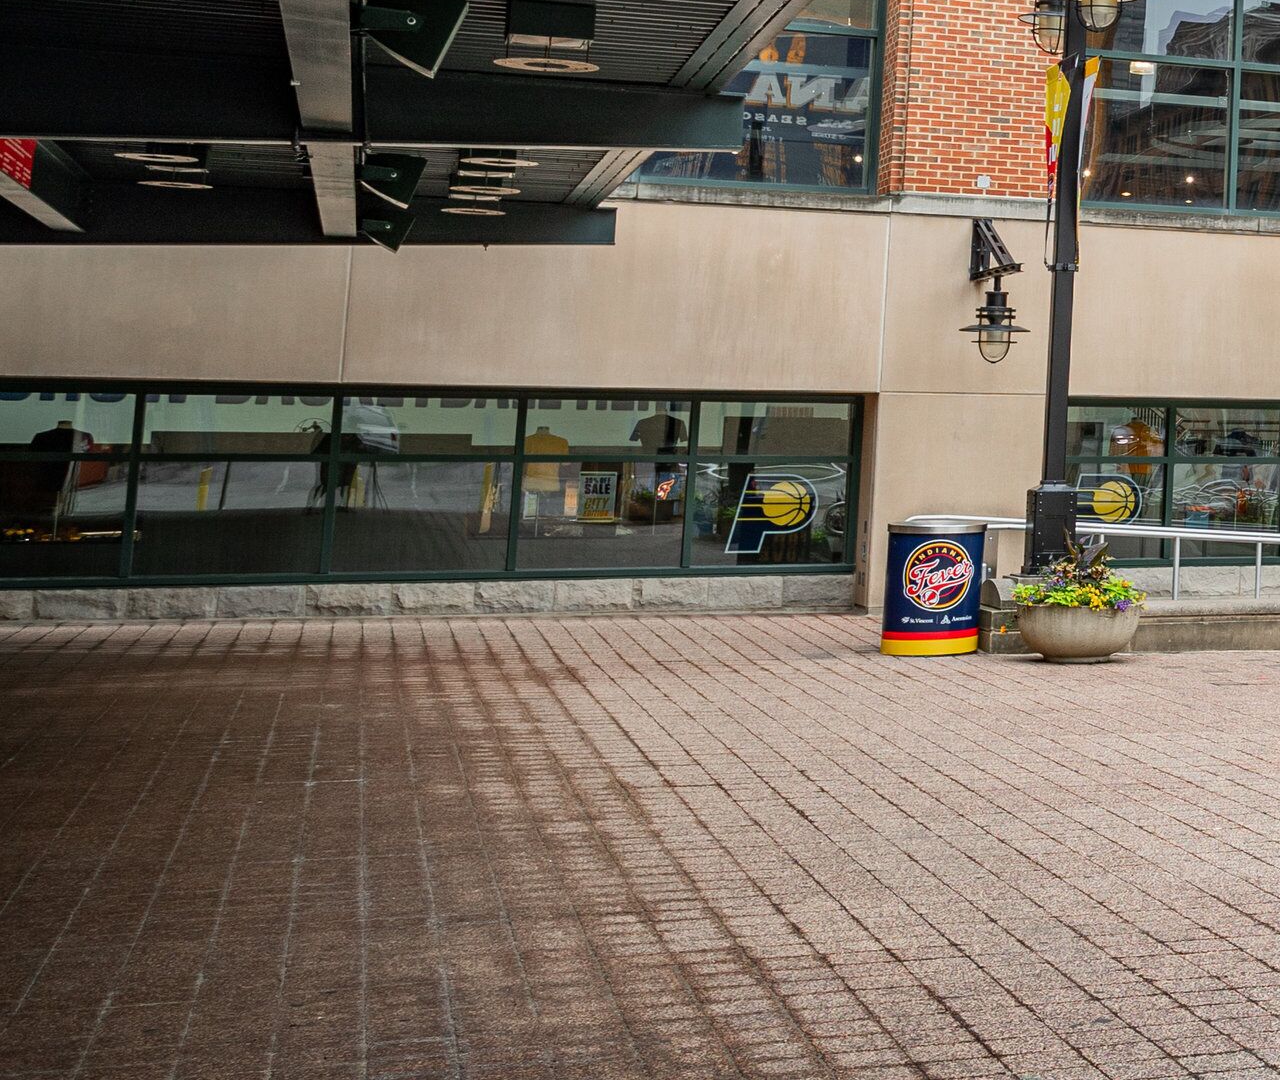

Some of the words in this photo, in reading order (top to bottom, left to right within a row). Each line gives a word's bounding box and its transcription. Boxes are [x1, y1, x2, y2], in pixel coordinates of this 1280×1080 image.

[584, 483, 611, 495] SALE
[914, 547, 963, 565] INDIANA
[907, 558, 974, 597] Fever
